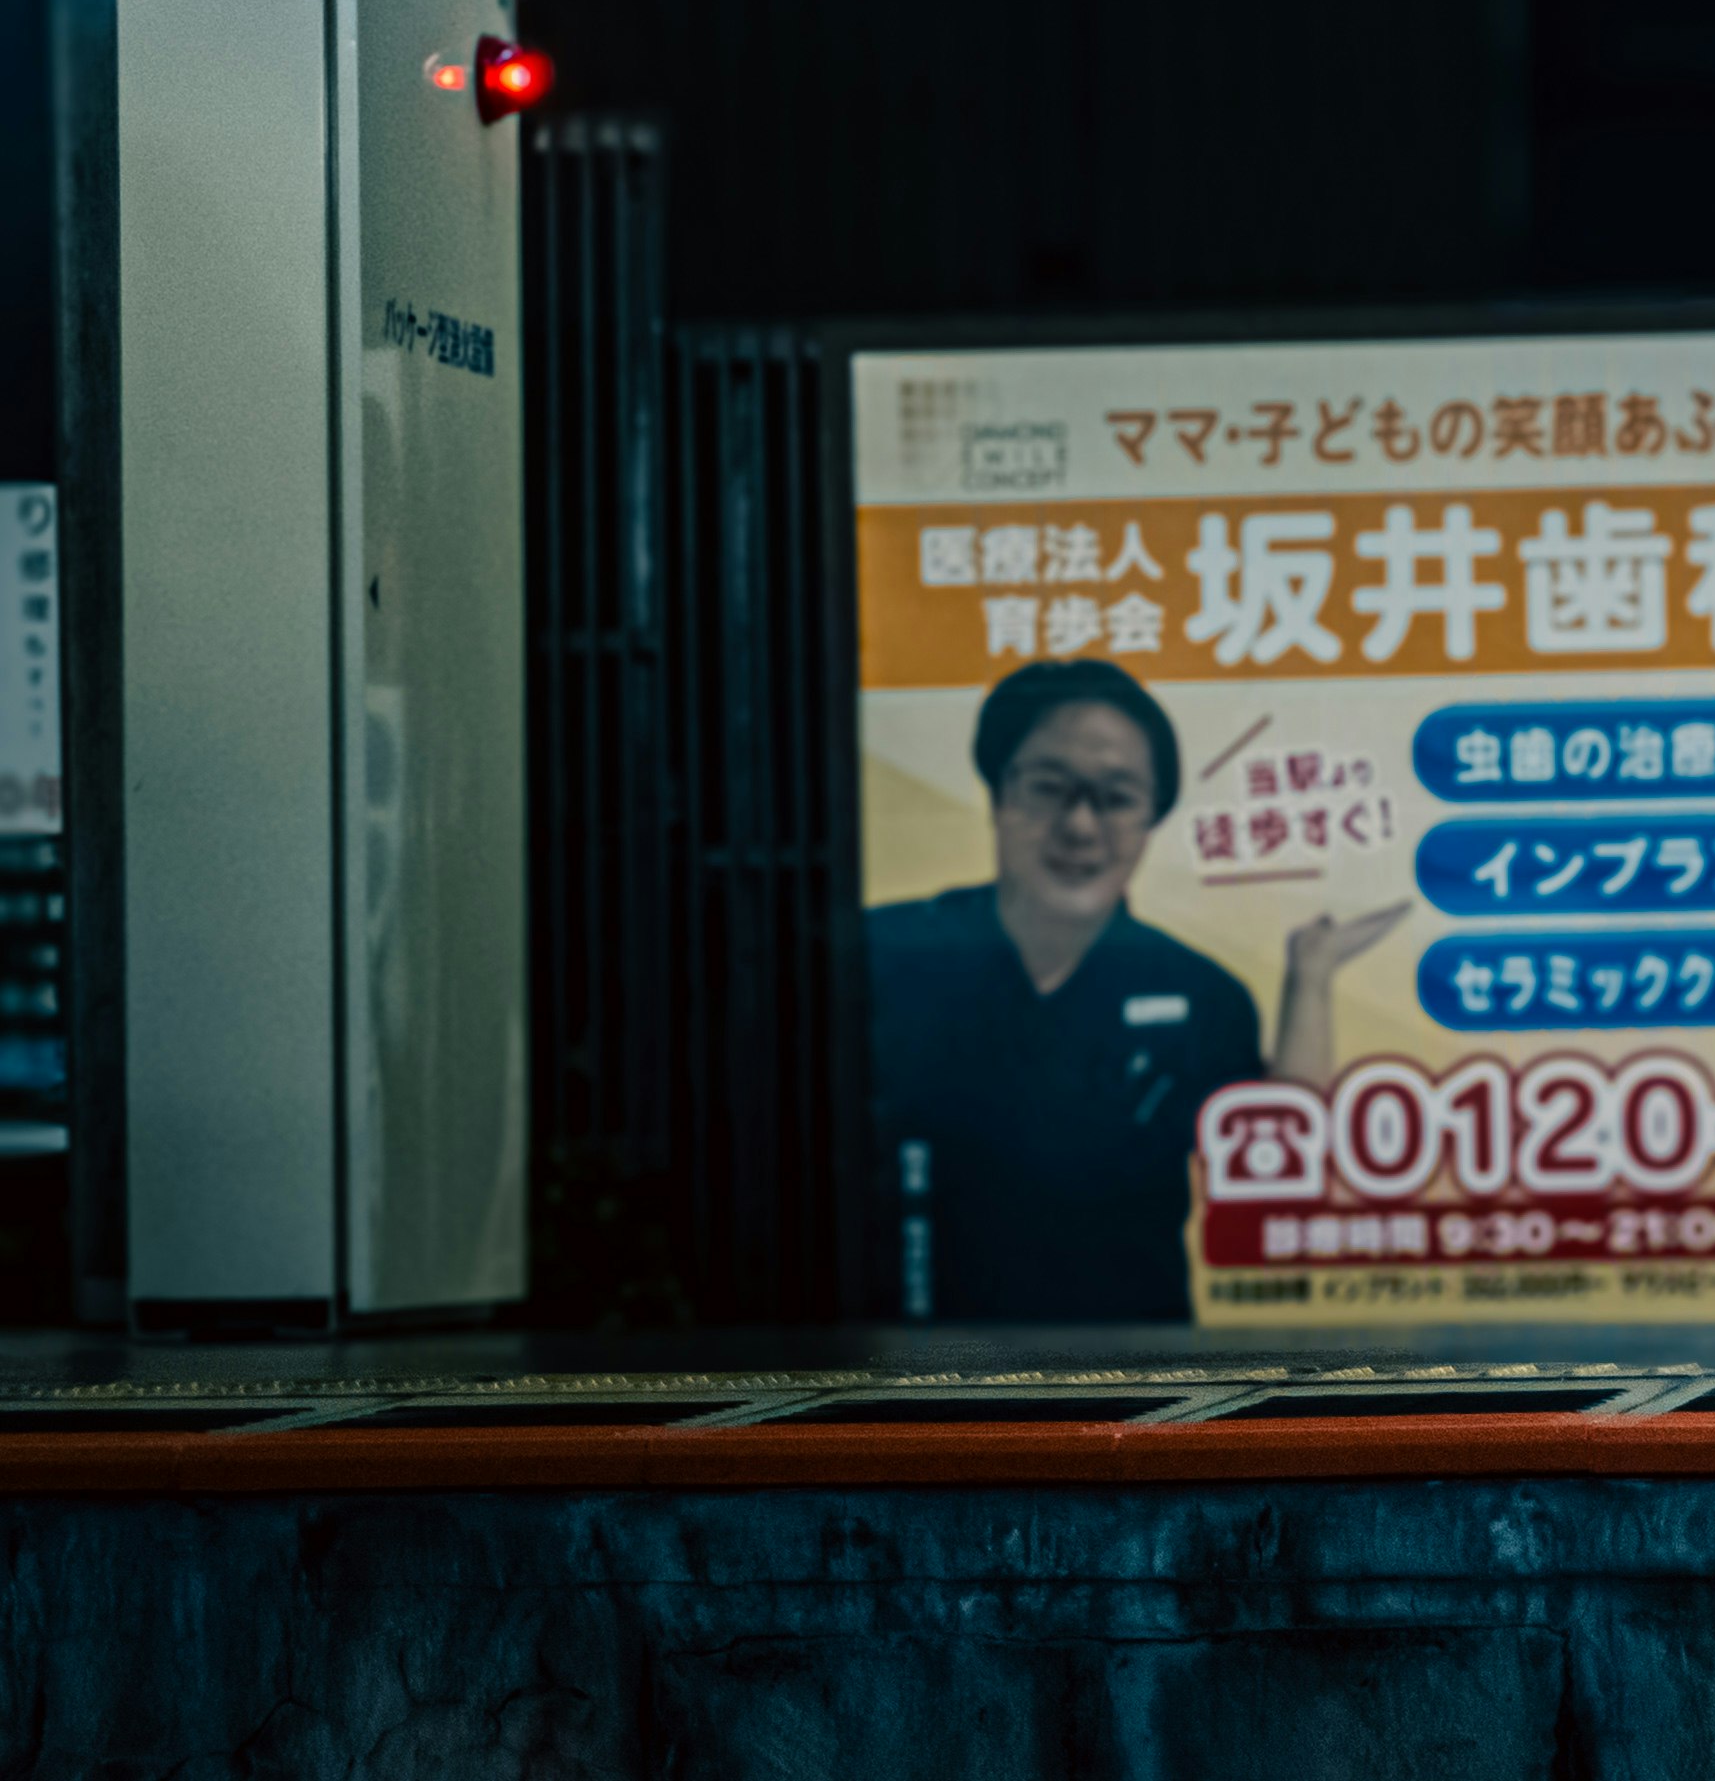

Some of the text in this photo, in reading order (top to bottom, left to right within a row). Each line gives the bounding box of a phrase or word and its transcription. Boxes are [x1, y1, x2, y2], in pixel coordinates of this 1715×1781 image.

[918, 520, 1165, 587] 医療法人
[984, 592, 1166, 657] 育歩会
